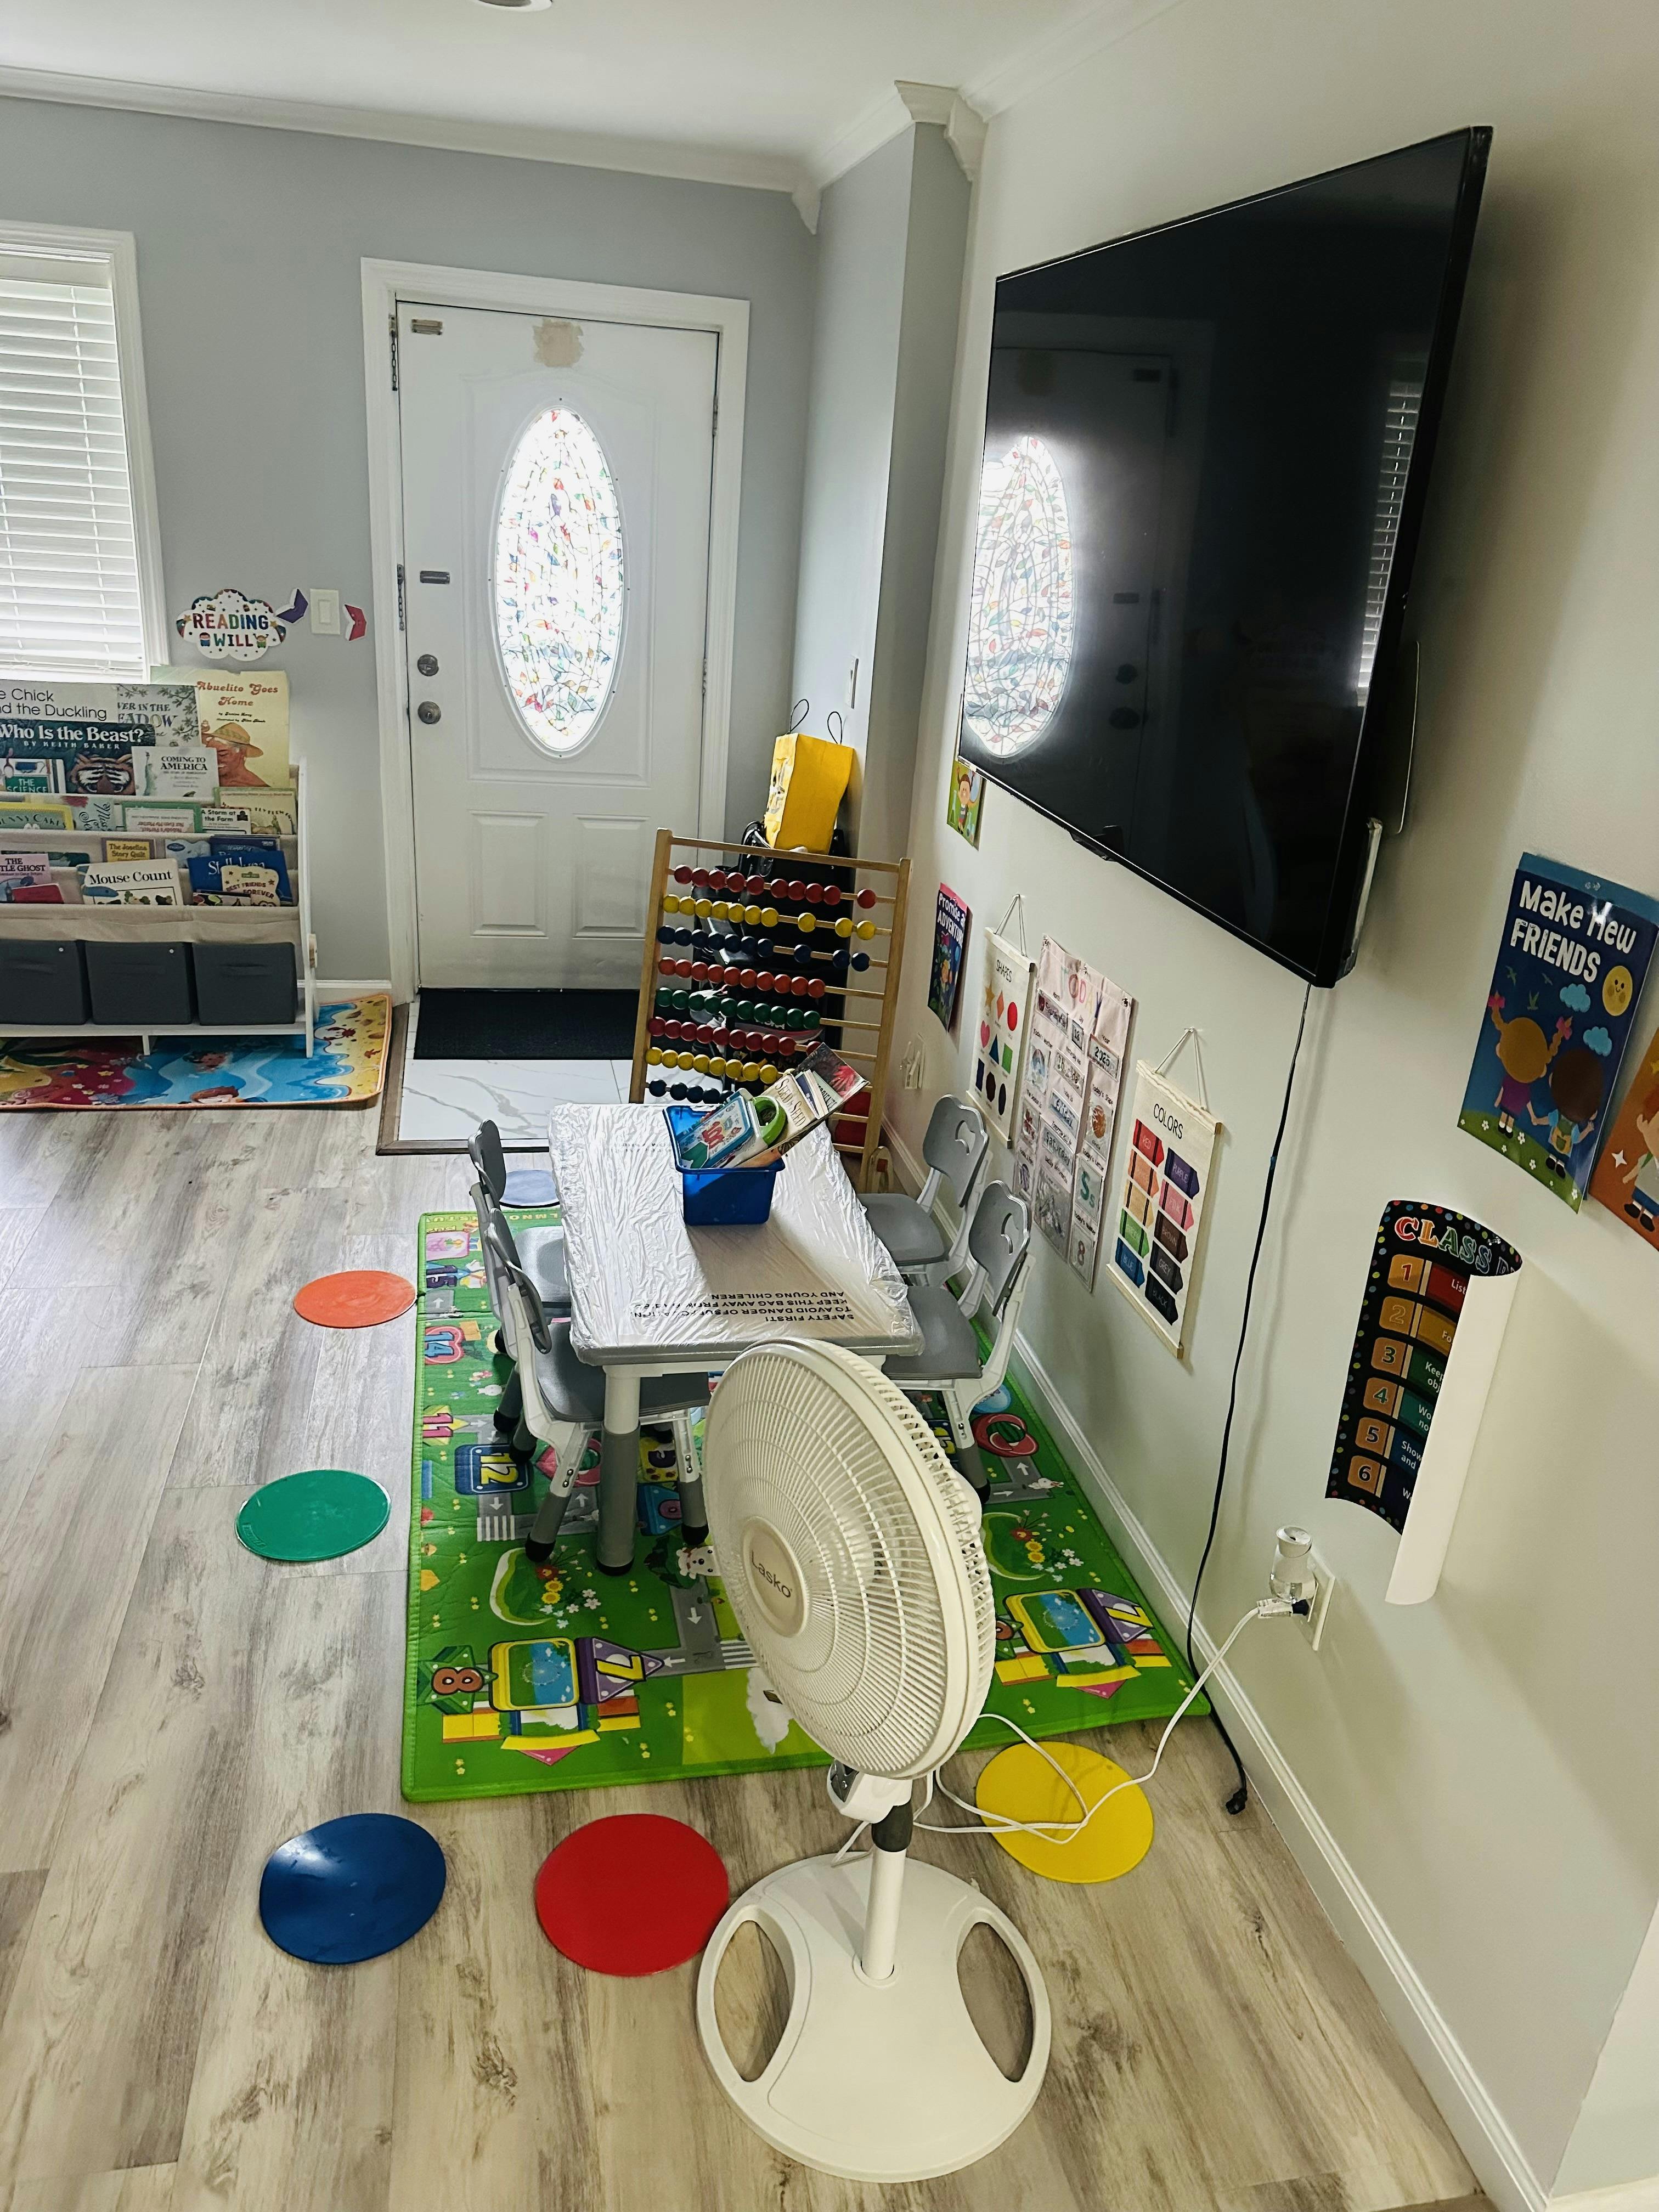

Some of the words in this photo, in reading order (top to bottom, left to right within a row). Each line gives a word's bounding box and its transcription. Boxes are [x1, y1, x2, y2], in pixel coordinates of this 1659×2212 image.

[193, 613, 268, 630] READING
[213, 633, 253, 647] WILL
[12, 688, 54, 701] Chick
[197, 681, 244, 692] Abuelito
[250, 684, 278, 695] Goes
[218, 696, 253, 706] Home
[16, 703, 41, 715] the
[46, 704, 107, 721] Duckling
[119, 713, 178, 727] EADOW
[0, 724, 34, 738] Who
[38, 725, 54, 740] Is
[57, 726, 83, 741] the
[87, 727, 144, 743] Beast?
[89, 874, 129, 884] Mouse
[133, 870, 173, 882] Count
[243, 889, 274, 899] FOREVER
[938, 893, 961, 922] Promise
[1519, 880, 1584, 929] Make
[1510, 918, 1601, 983] FRIENDS
[996, 960, 1012, 983] SHAPES
[1060, 964, 1104, 1019] TODAY
[775, 1078, 793, 1104] SEED
[790, 1101, 806, 1127] SEED
[1154, 1103, 1183, 1139] COLORS
[1046, 1132, 1070, 1166] Saturday
[1173, 1164, 1189, 1183] PURPLE
[1080, 1171, 1095, 1208] Ss
[1162, 1228, 1177, 1246] BROWN
[1395, 1216, 1492, 1274] CLASS
[1077, 1240, 1085, 1266] 8
[1123, 1256, 1134, 1271] BLUE
[1158, 1259, 1171, 1274] GREY
[1402, 1263, 1413, 1282] 1
[1153, 1290, 1167, 1308] BLACK
[1389, 1305, 1406, 1324] 2
[425, 1331, 454, 1358] 14
[1382, 1346, 1396, 1364] 3
[1427, 1378, 1441, 1393] obj
[1373, 1387, 1388, 1403] 4
[1418, 1404, 1431, 1420] Wo
[423, 1413, 453, 1438] 11
[1365, 1426, 1379, 1443] 5
[1419, 1419, 1429, 1431] no
[480, 1452, 518, 1485] 12
[1401, 1455, 1417, 1470] and
[1358, 1465, 1371, 1481] 6
[751, 1549, 791, 1598] Lasko
[1105, 1605, 1154, 1629] 7
[594, 1654, 647, 1682] 7
[431, 1667, 484, 1696] 8
